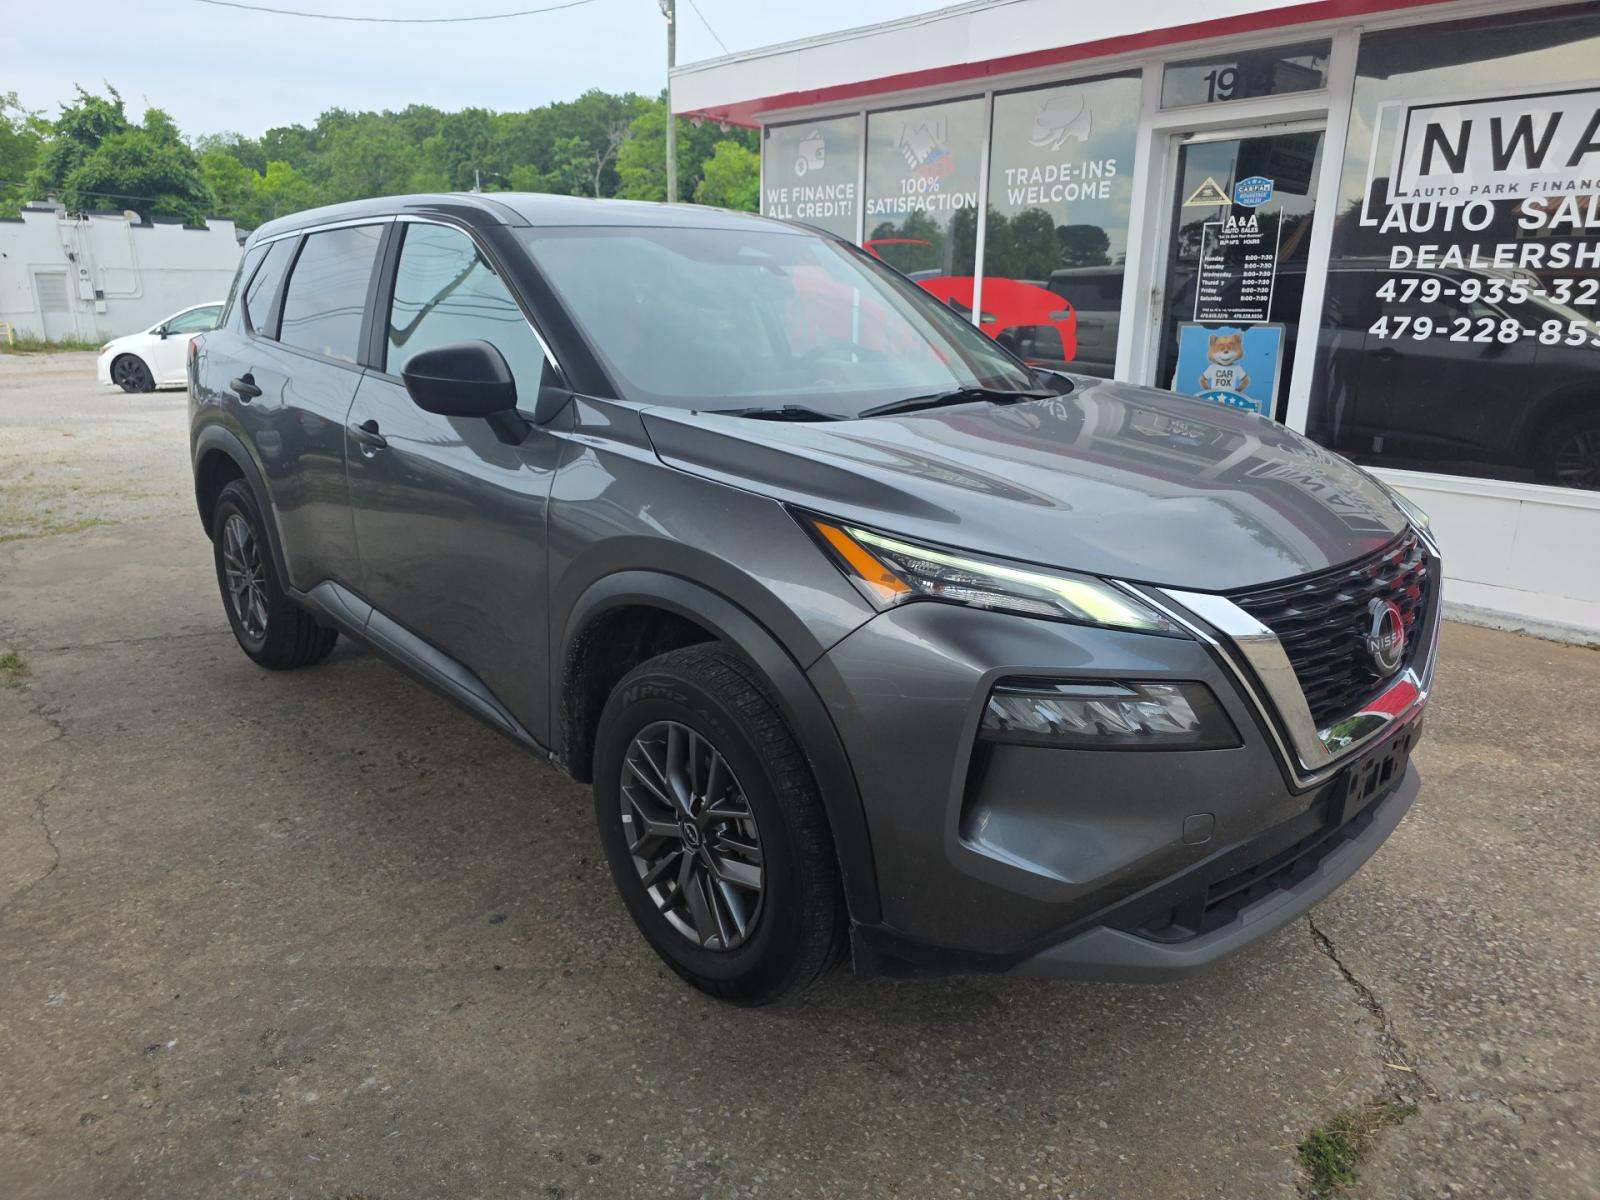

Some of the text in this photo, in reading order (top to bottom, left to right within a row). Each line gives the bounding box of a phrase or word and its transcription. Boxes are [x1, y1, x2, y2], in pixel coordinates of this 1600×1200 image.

[1005, 158, 1117, 186] TRADE-INS
[767, 183, 855, 203] WE FINANCE
[900, 176, 940, 194] 100%
[1007, 180, 1112, 206] WELCOME
[1411, 186, 1459, 198] AUTO
[1470, 183, 1520, 195] PARK
[768, 200, 853, 220] ALL CREDIT!
[866, 191, 977, 215] SATISFACTION
[1378, 199, 1496, 234] AUTO
[1389, 242, 1600, 269] DEALERSH
[1215, 369, 1233, 379] CAR
[1215, 378, 1232, 387] FOX
